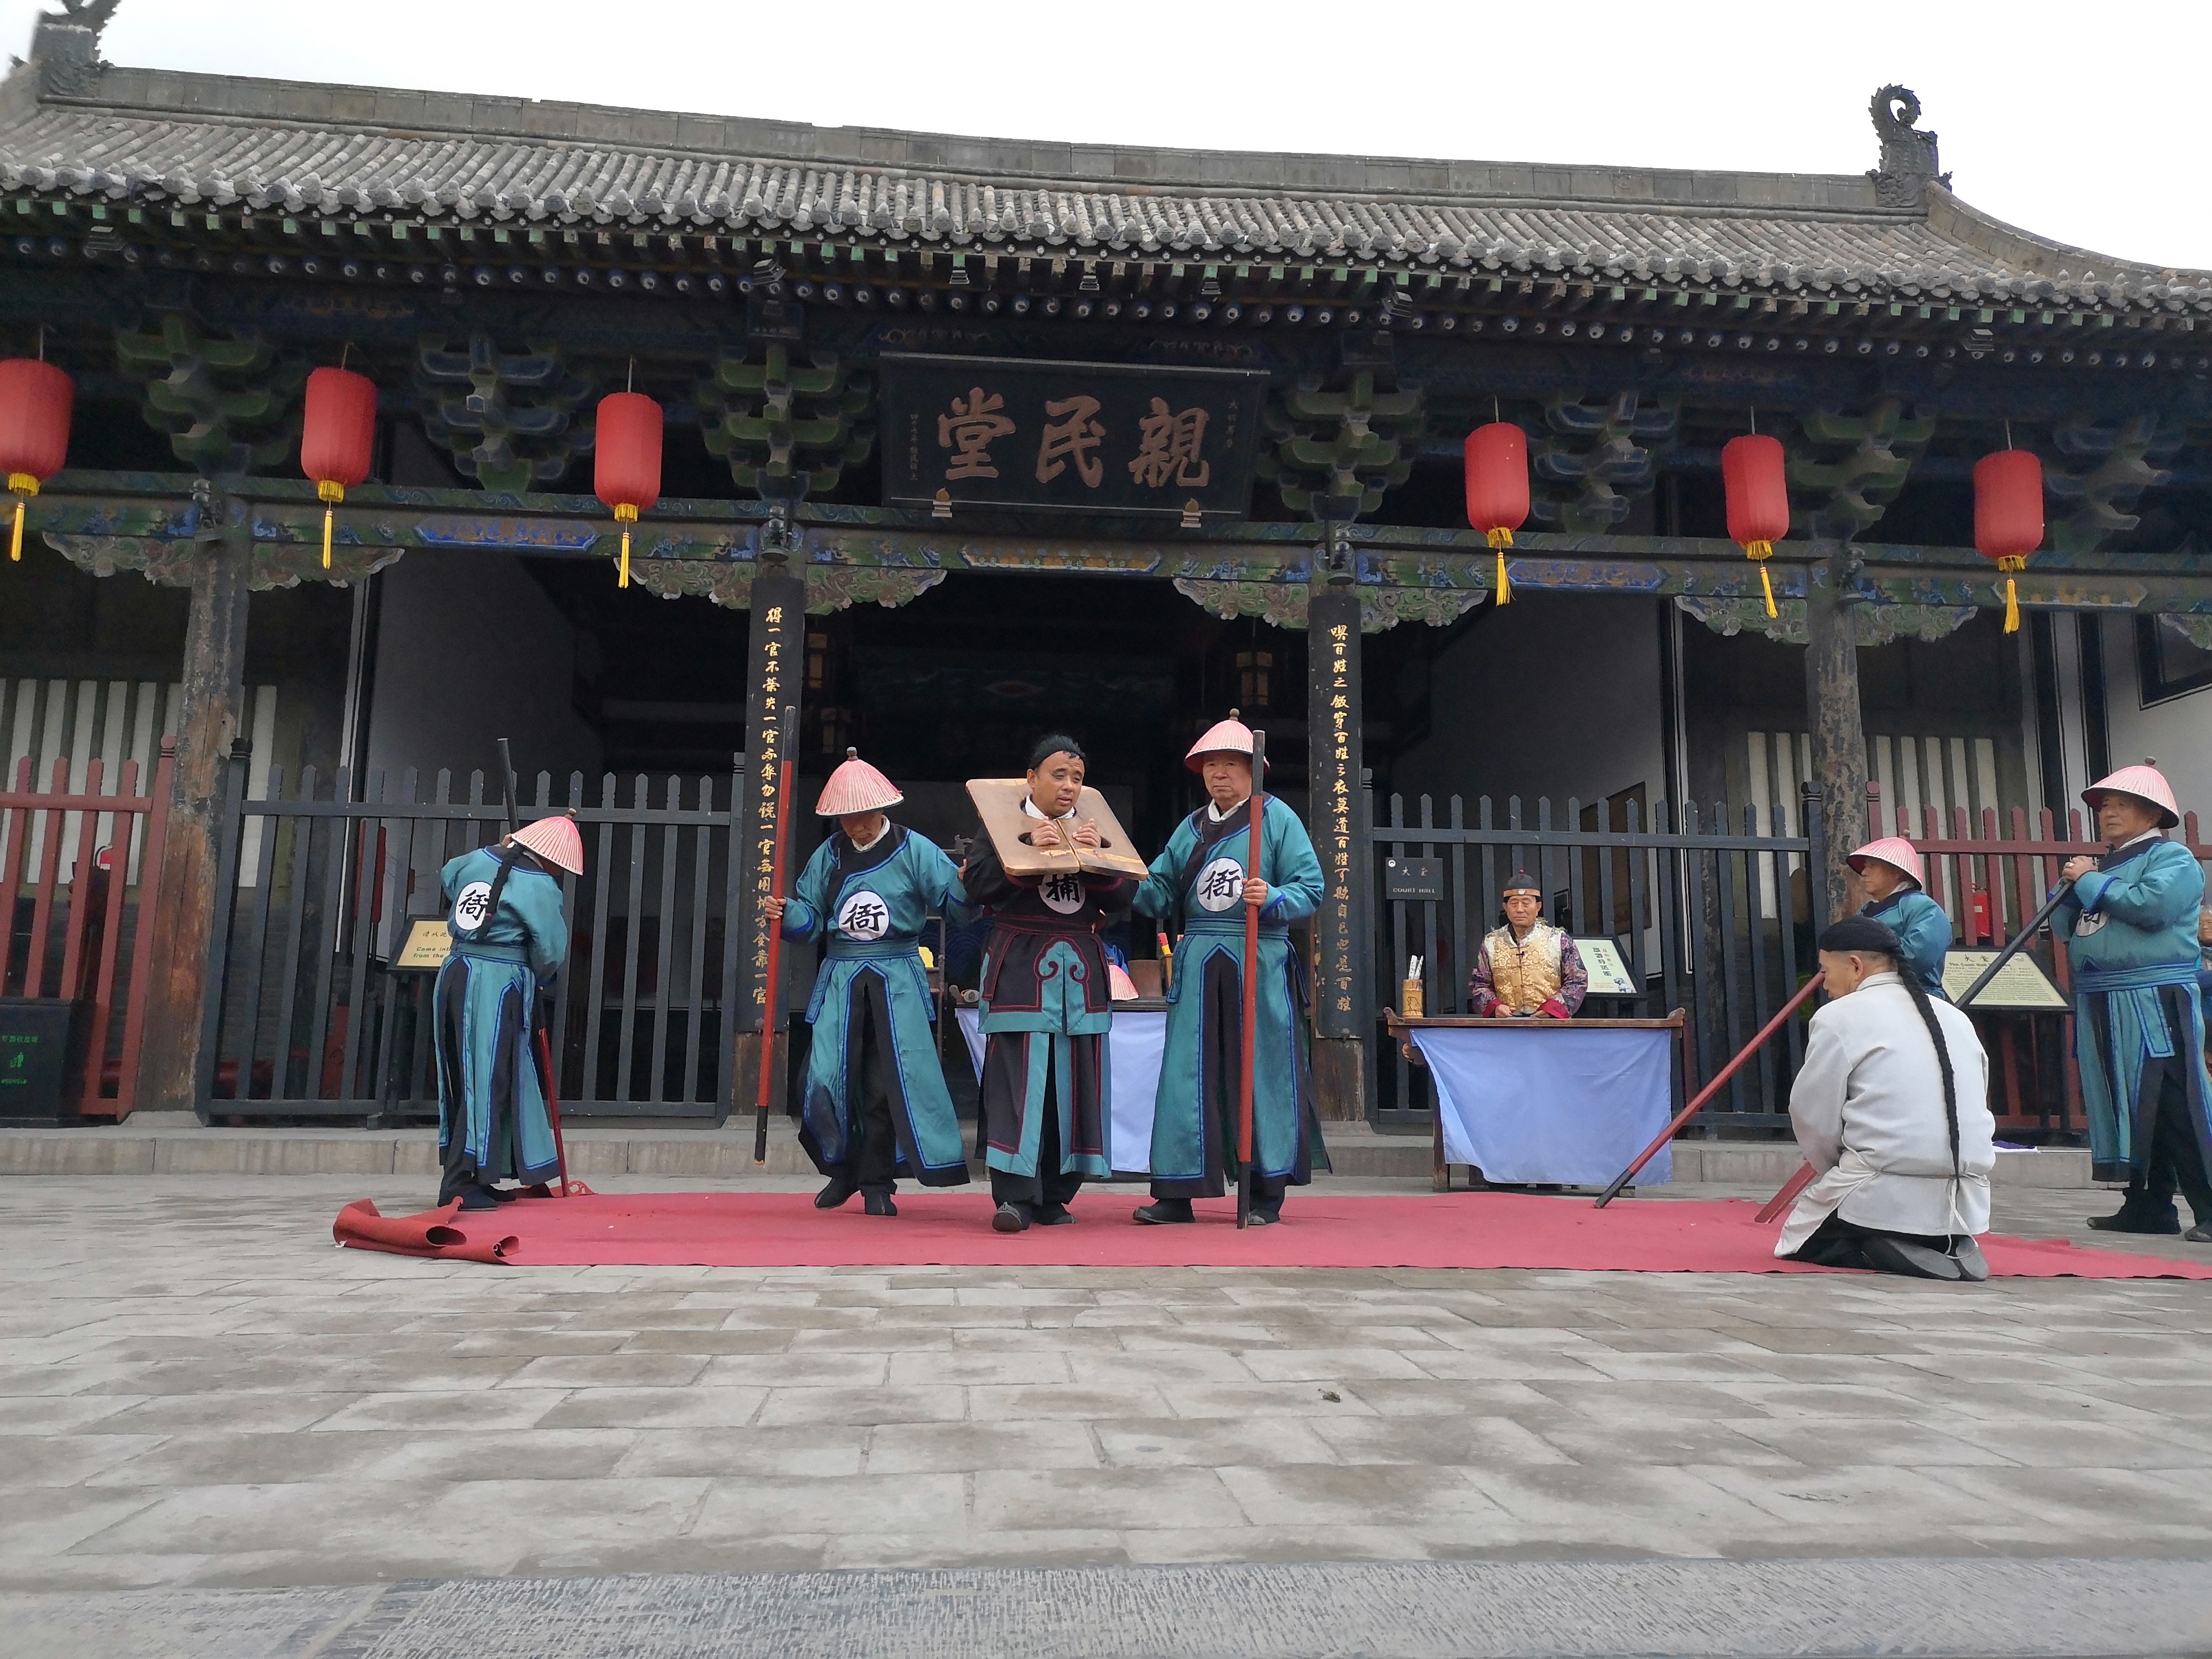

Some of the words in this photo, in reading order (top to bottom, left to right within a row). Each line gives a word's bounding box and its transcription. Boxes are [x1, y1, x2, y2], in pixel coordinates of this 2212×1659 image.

[1045, 873, 1080, 903] 捕
[1199, 869, 1241, 900] 衙
[841, 903, 886, 932] 衙
